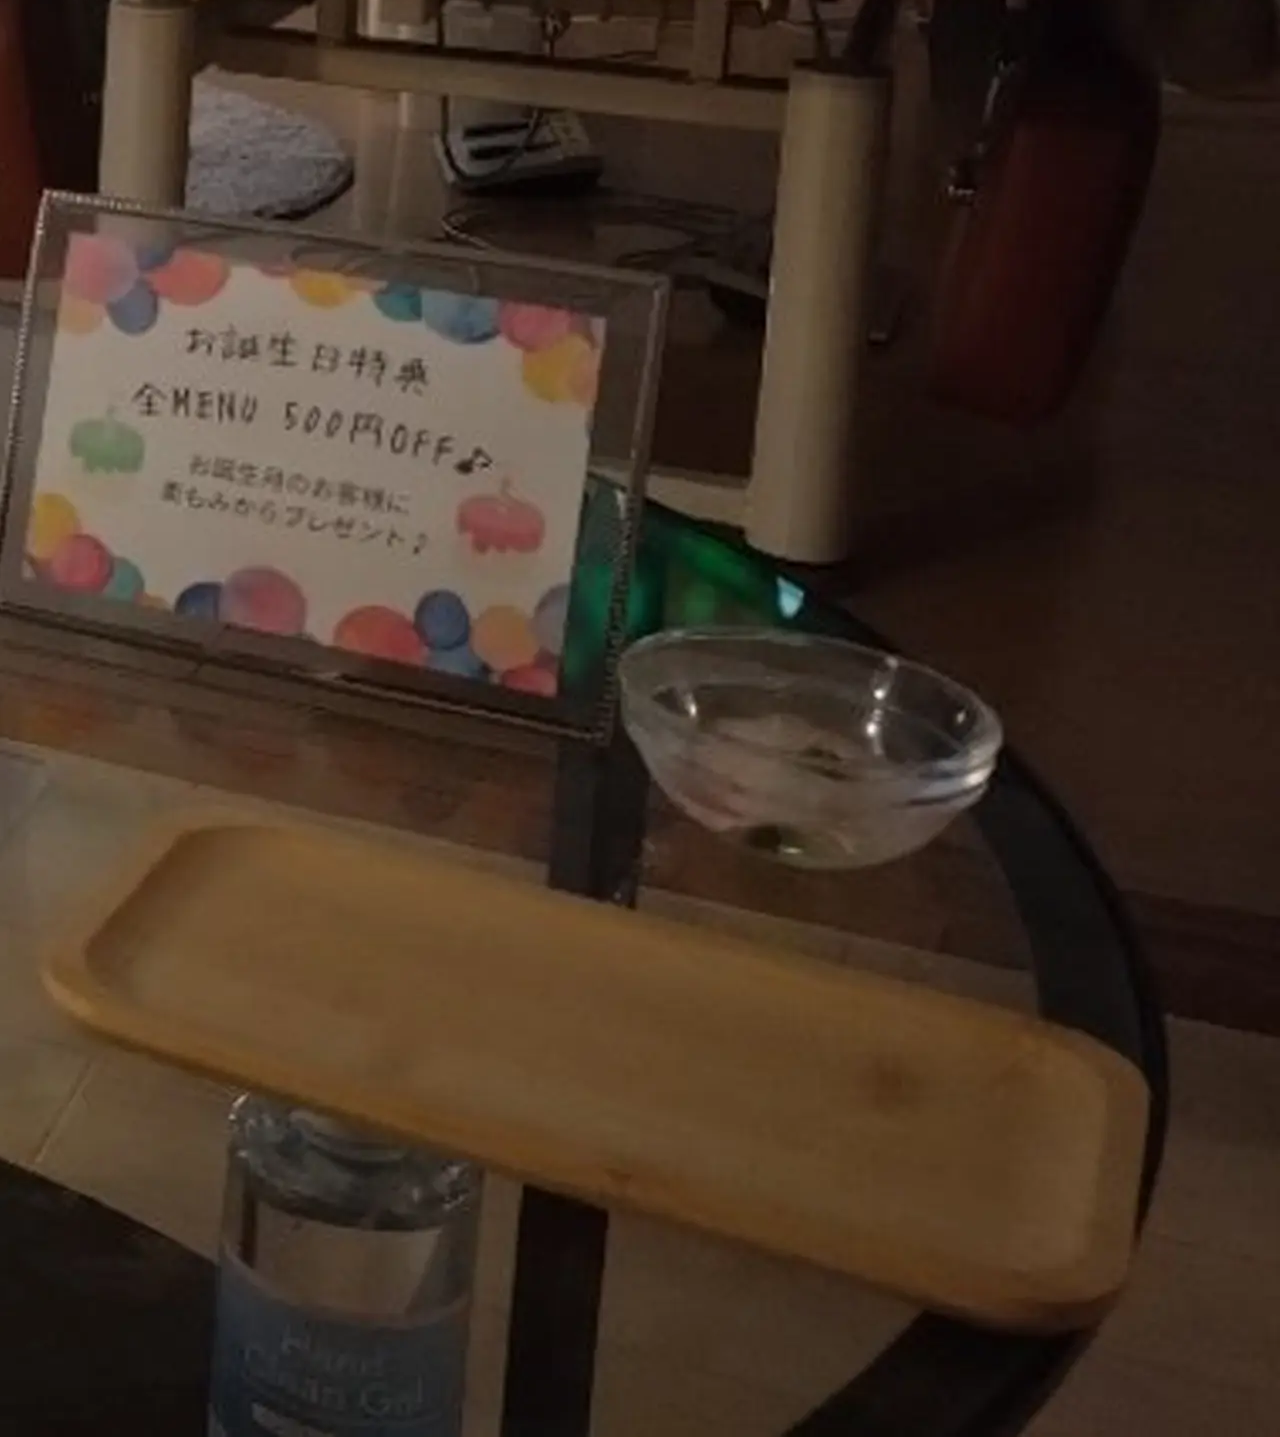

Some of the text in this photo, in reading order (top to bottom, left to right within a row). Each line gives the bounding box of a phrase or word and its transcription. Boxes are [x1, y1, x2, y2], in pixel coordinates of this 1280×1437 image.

[185, 326, 431, 396] お誕生日特典
[133, 382, 259, 426] 全MENU
